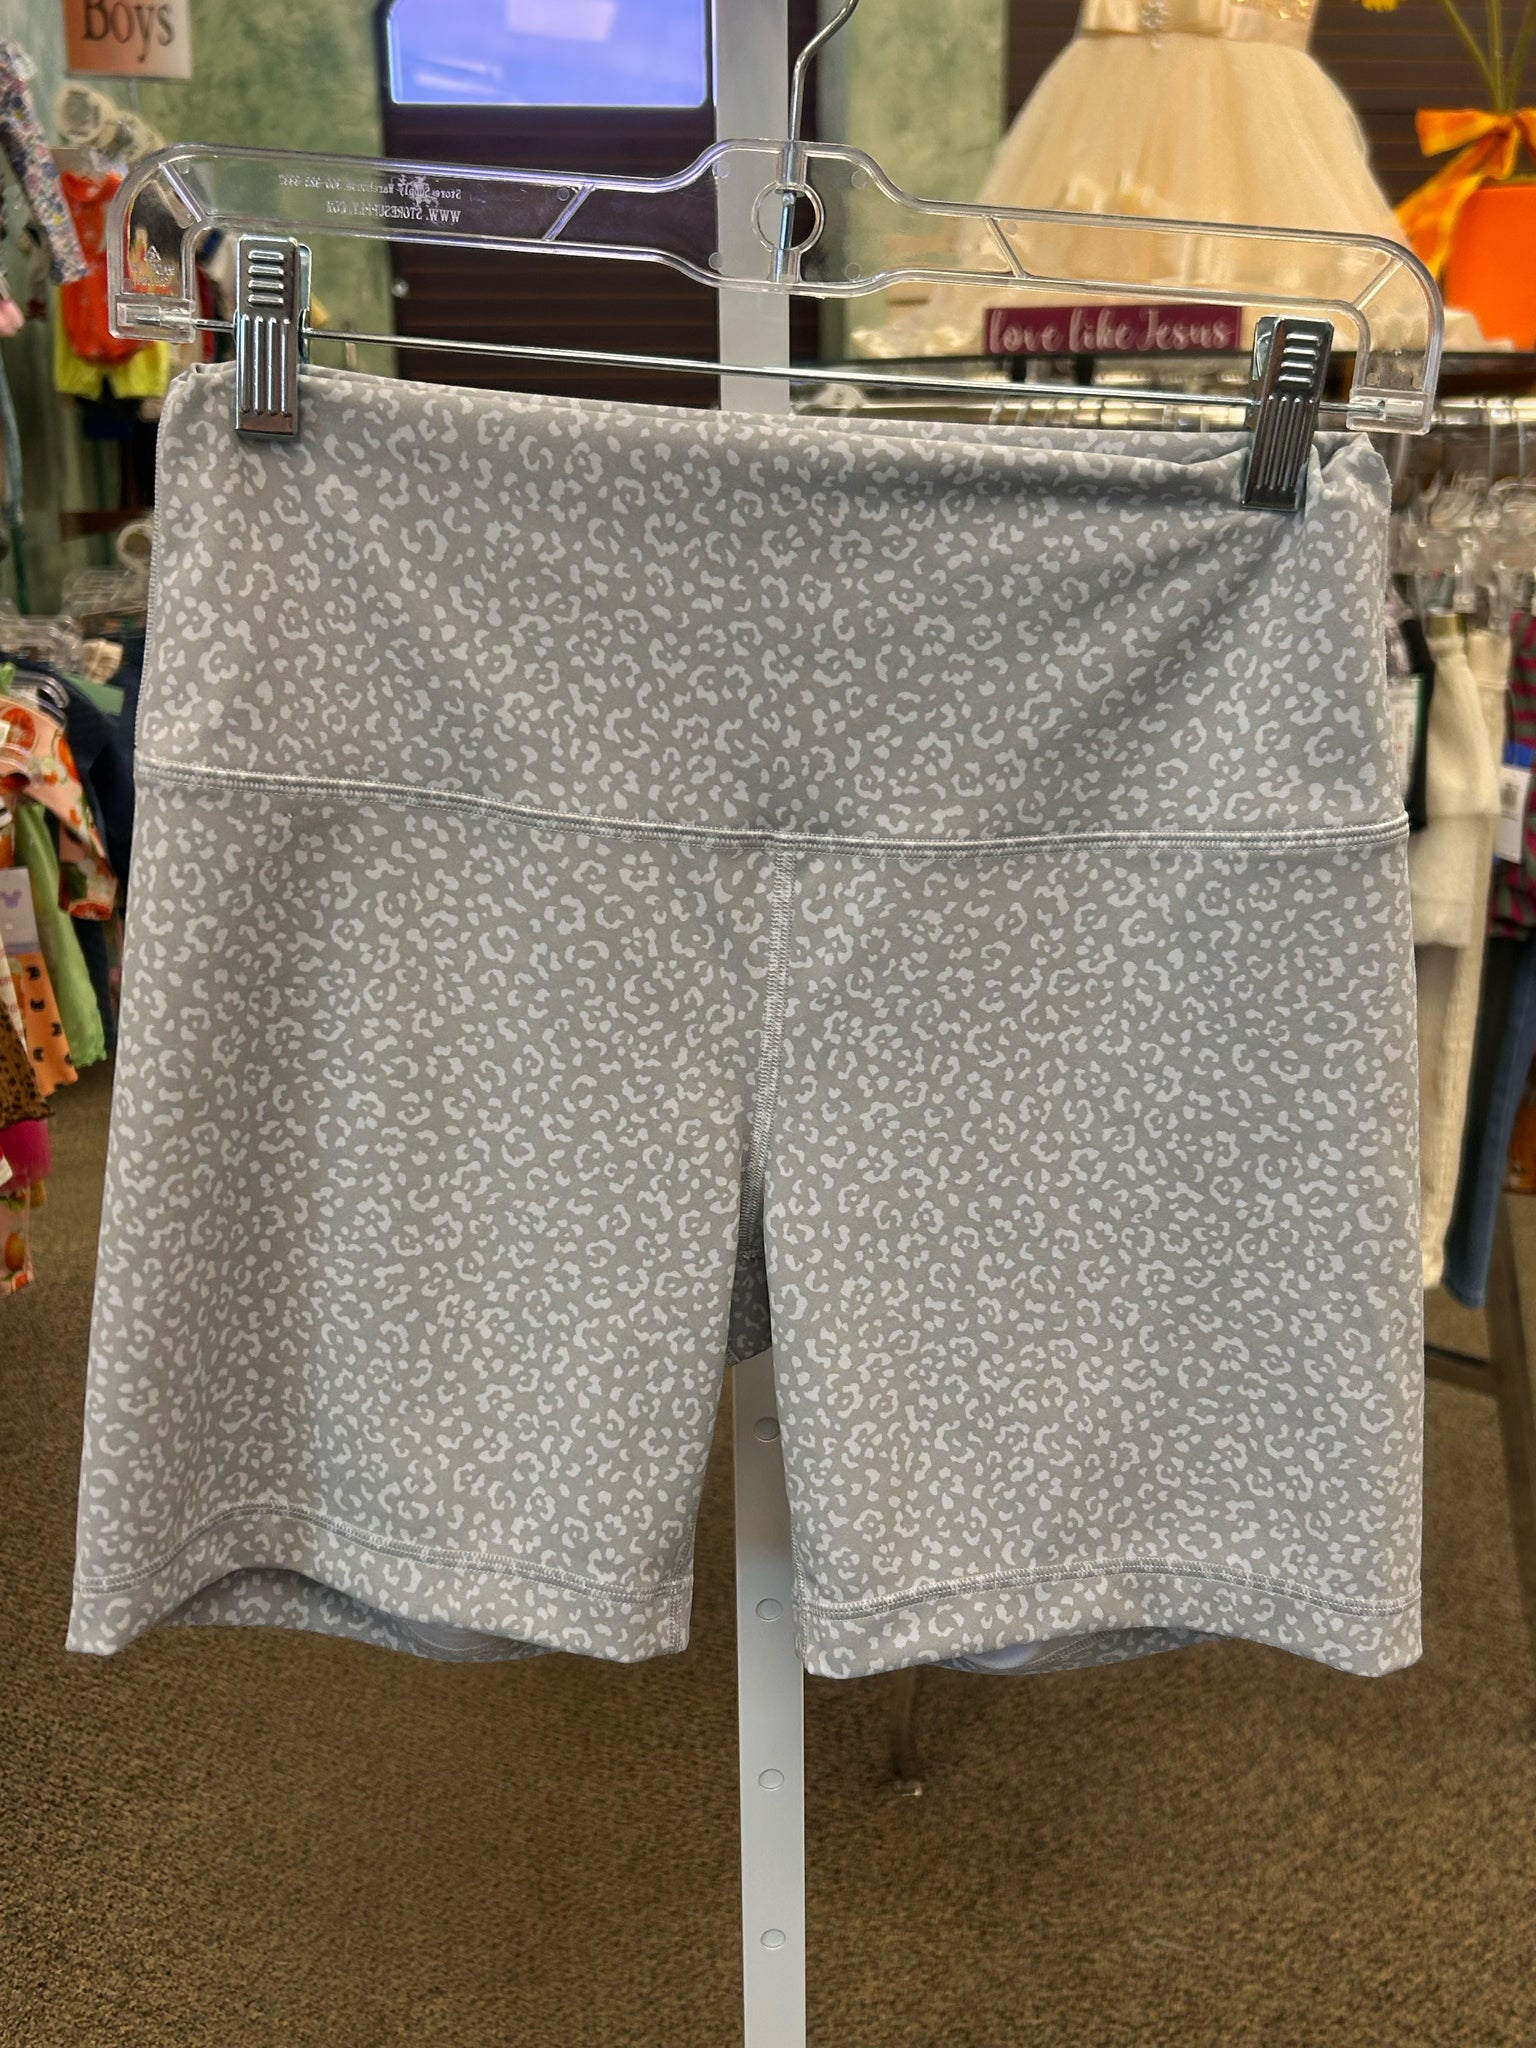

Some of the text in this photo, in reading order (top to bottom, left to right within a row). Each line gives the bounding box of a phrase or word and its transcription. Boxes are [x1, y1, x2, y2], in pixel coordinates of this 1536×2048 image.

[82, 0, 175, 62] Boys
[989, 306, 1234, 353] love like Jesus
